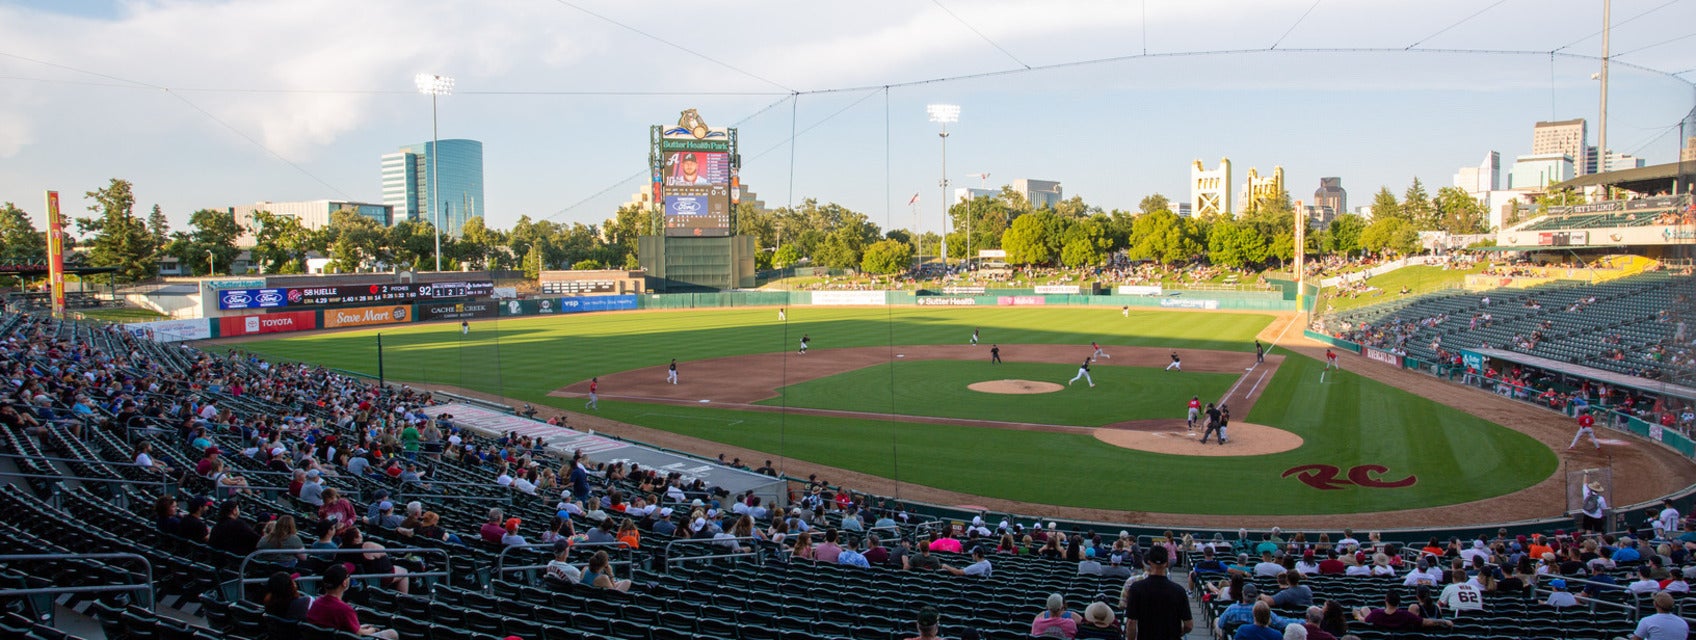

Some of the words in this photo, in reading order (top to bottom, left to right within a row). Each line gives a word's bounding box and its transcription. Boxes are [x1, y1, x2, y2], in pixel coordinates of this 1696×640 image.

[663, 141, 686, 149] Sutter
[687, 141, 710, 150] Health
[678, 202, 696, 210] Ford
[217, 281, 240, 289] Sutter
[419, 286, 431, 296] 92
[229, 295, 247, 303] Ford
[261, 293, 278, 302] Ford
[337, 312, 360, 323] Save
[362, 310, 389, 322] Mart
[262, 318, 293, 326] TOYOTA
[1458, 591, 1478, 603] 62
